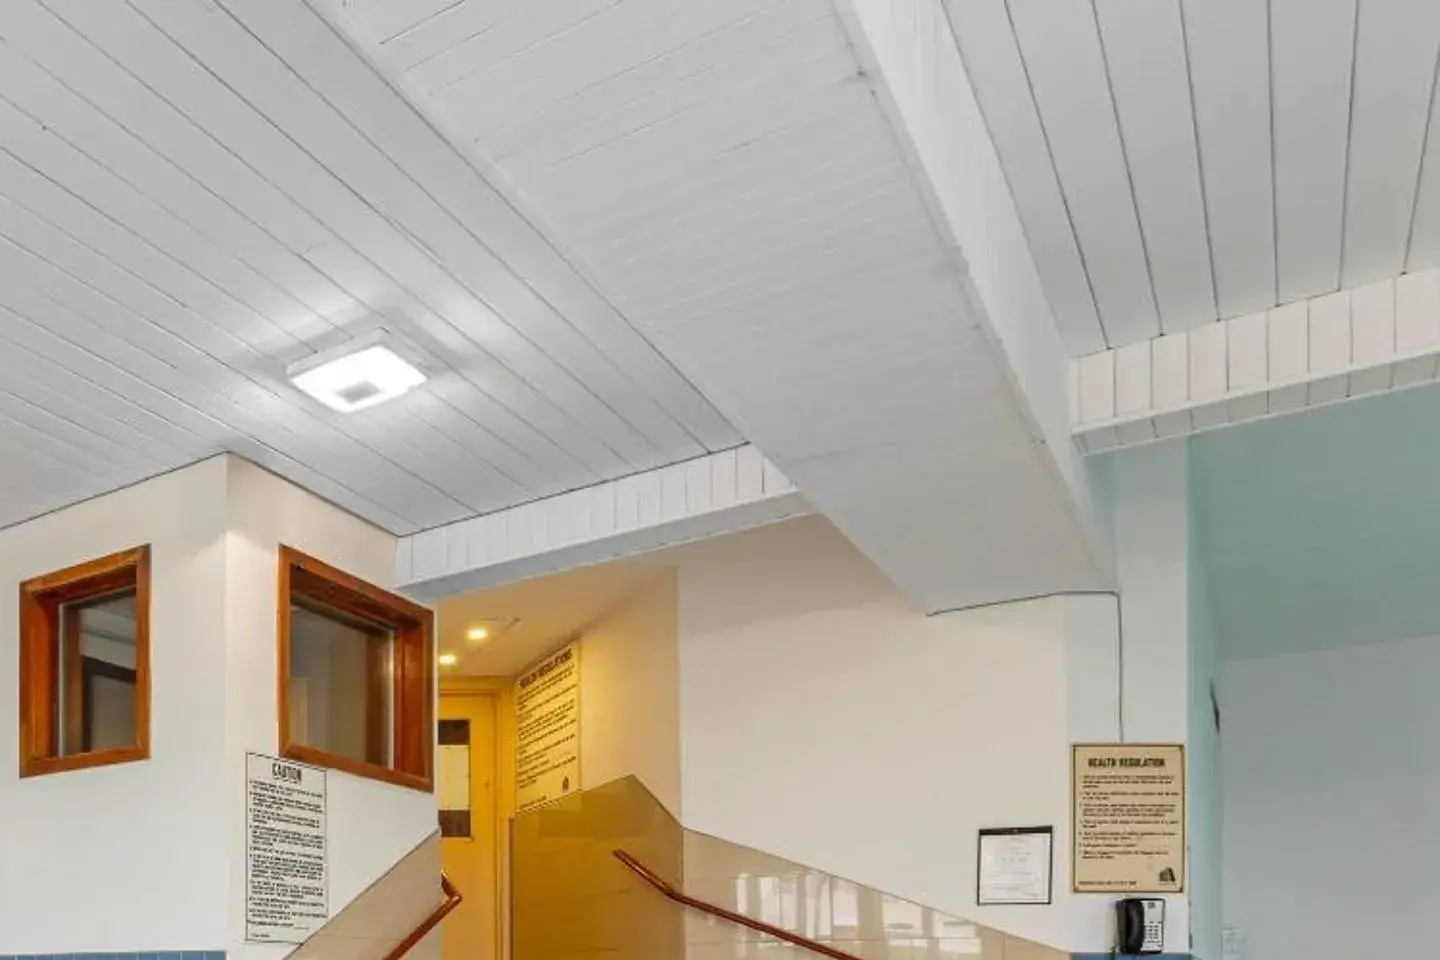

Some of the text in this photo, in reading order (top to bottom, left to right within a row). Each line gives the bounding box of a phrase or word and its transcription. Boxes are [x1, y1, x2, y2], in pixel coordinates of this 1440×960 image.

[1088, 757, 1165, 768] HEALTH REGULATION
[272, 763, 302, 784] CAUTION
